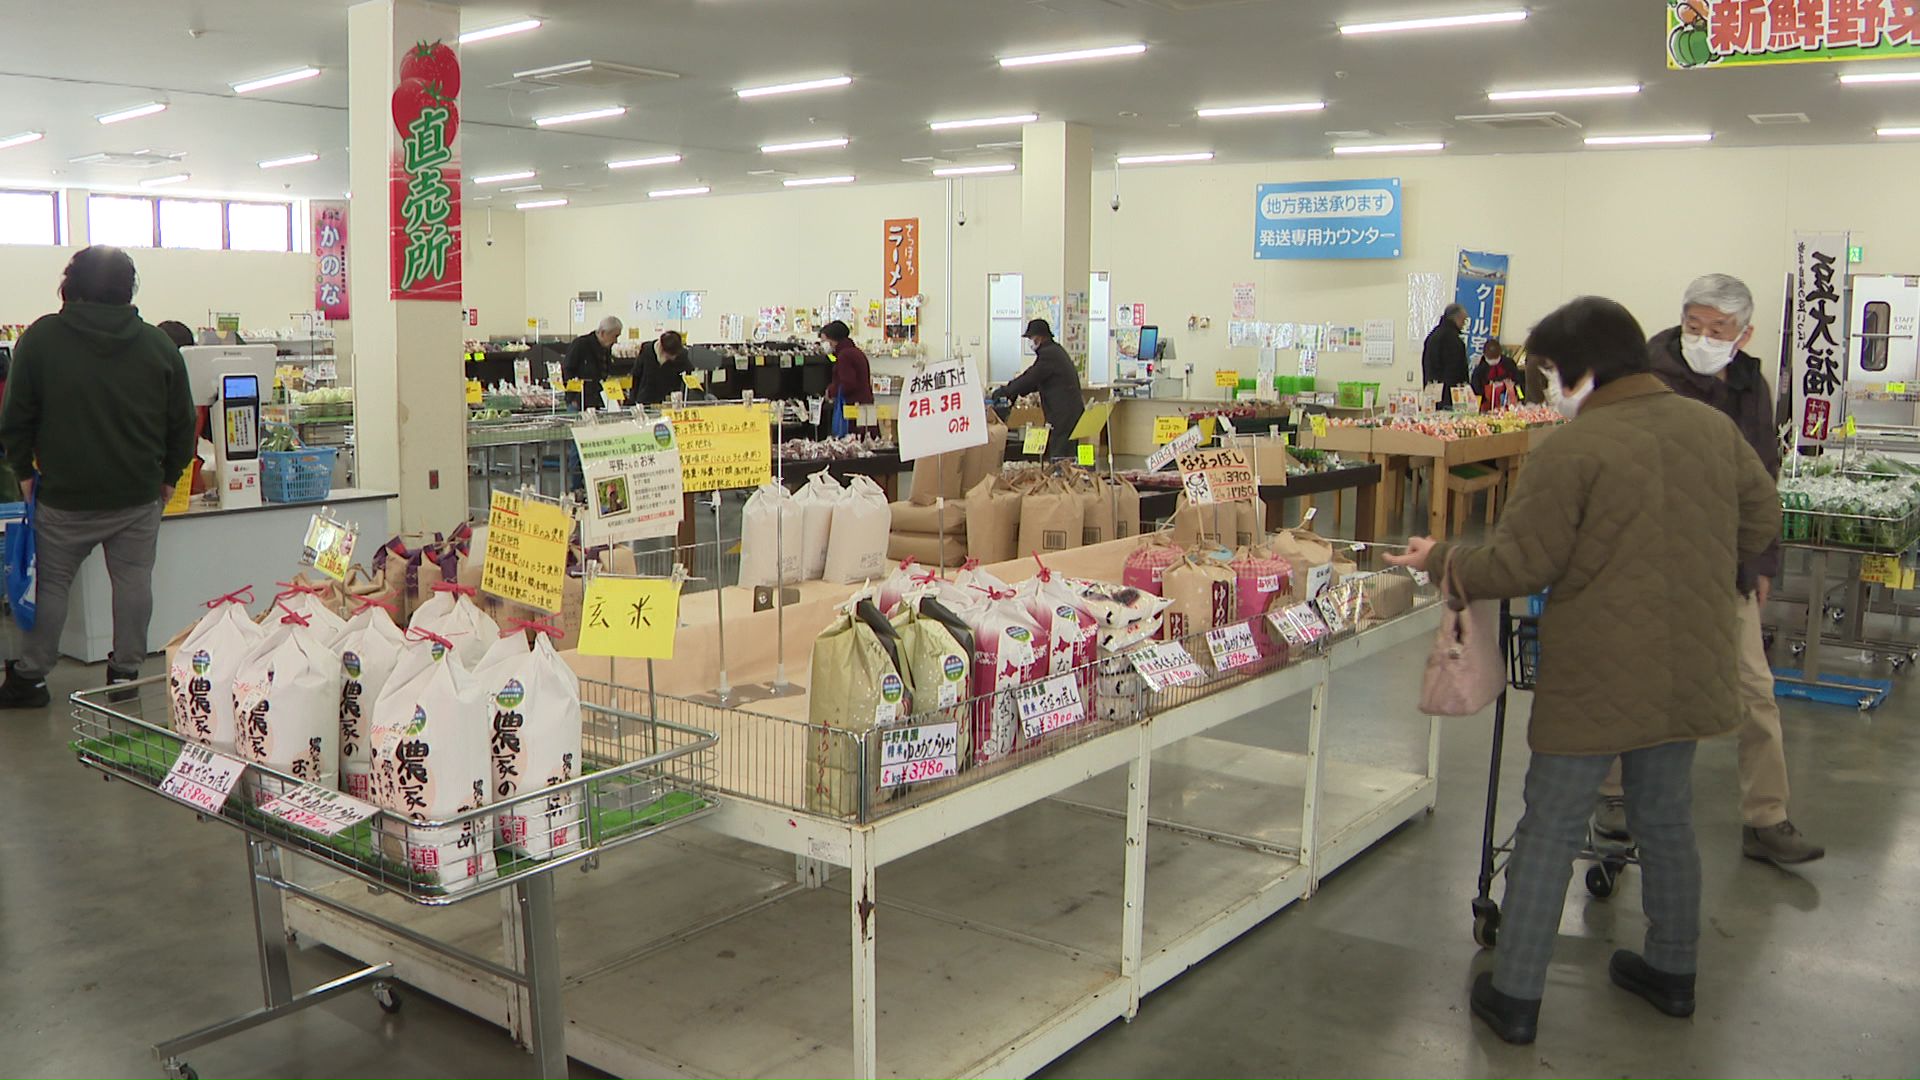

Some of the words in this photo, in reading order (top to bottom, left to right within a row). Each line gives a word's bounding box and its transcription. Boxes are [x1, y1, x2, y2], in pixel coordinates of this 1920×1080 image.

[402, 108, 451, 288] 直売所
[1266, 194, 1387, 214] 地方発送承ります
[1259, 226, 1396, 247] 発送専用カウンター
[320, 225, 342, 306] かのな
[910, 367, 967, 393] お米値下げ
[909, 392, 961, 418] 2月、3月
[948, 416, 970, 433] のみ
[609, 455, 656, 471] 平野さんのお米
[1180, 449, 1244, 471] ななつぼし
[588, 597, 653, 629] 玄米
[885, 728, 919, 744] 平野農園
[491, 710, 523, 796] 農家の
